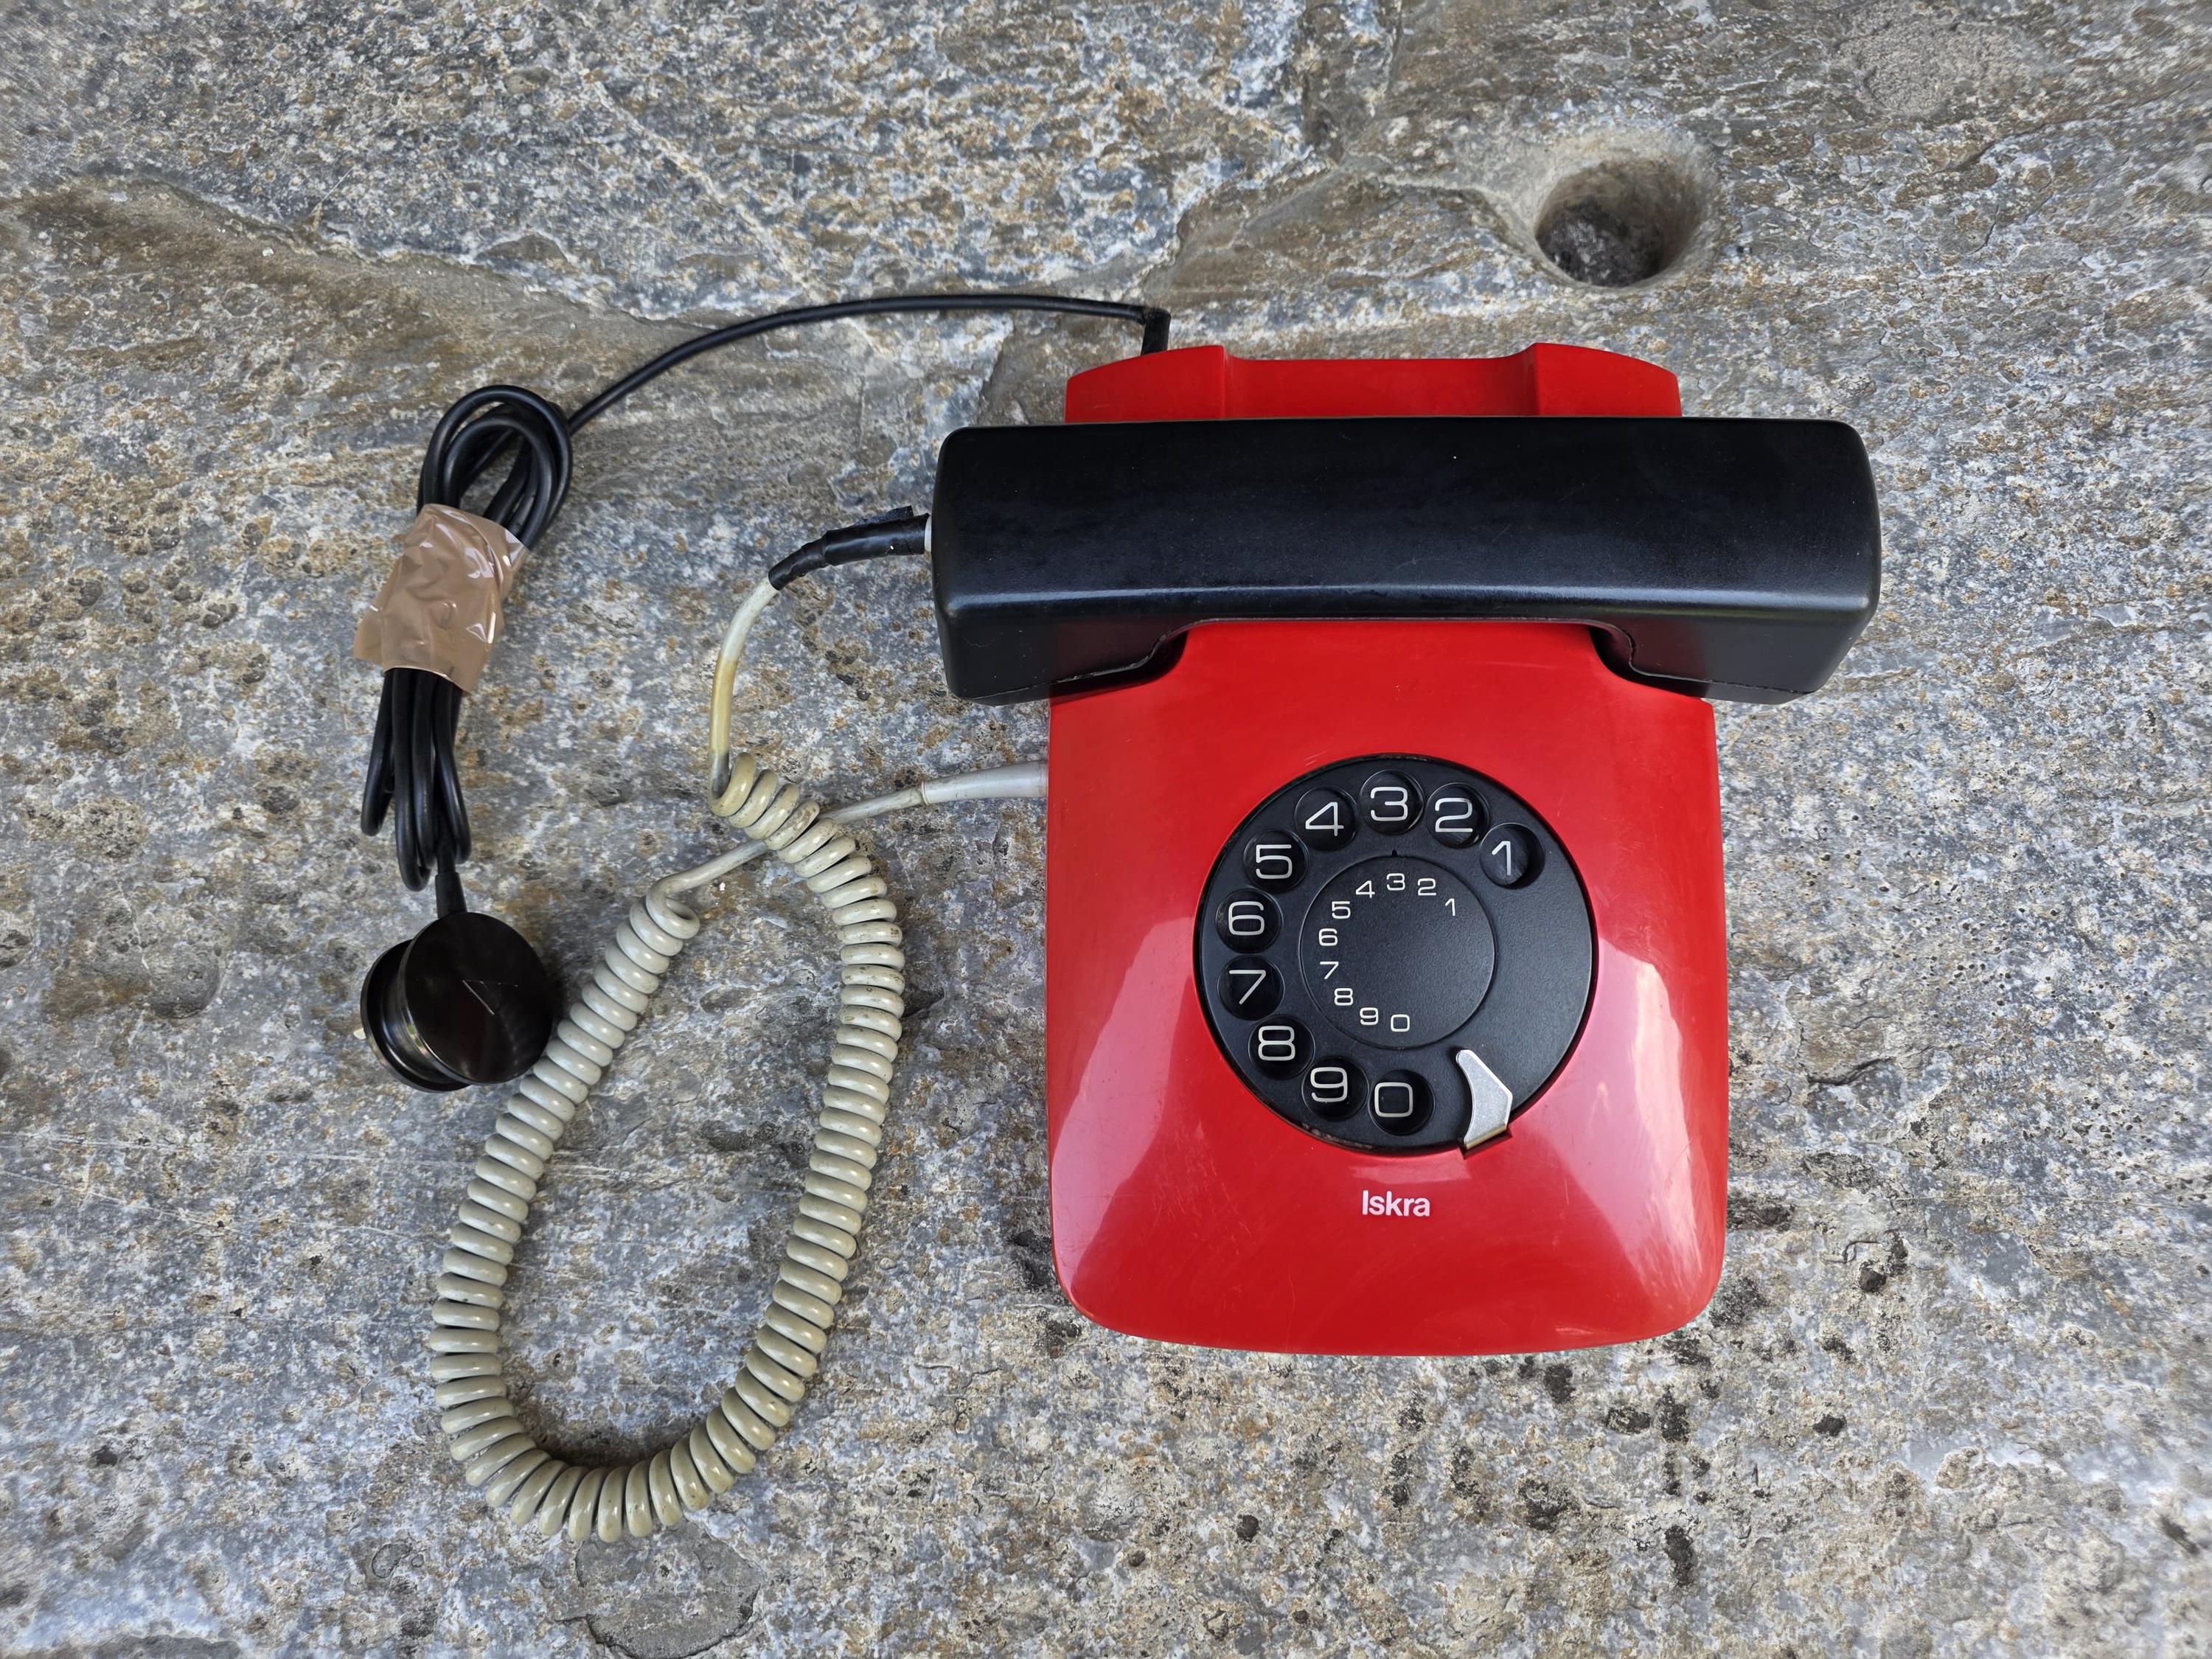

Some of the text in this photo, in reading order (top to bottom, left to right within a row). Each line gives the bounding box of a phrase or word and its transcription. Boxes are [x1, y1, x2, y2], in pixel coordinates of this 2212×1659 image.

[1370, 786, 1408, 821] 3
[1434, 797, 1473, 832] 2
[1305, 801, 1344, 836] 4
[1256, 844, 1293, 879] 5
[1491, 841, 1512, 876] 1
[1355, 880, 1376, 899] 4
[1386, 872, 1406, 891] 3
[1417, 877, 1437, 896] 2
[1228, 901, 1265, 936] 6
[1331, 900, 1351, 919] 5
[1444, 897, 1456, 917] 1
[1318, 928, 1338, 947] 6
[1319, 961, 1339, 980] 7
[1228, 970, 1266, 1005] 7
[1334, 987, 1354, 1006] 8
[1359, 1006, 1379, 1026] 9
[1390, 1014, 1411, 1032] 0
[1258, 1025, 1295, 1061] 8
[1310, 1066, 1348, 1103] 9
[1374, 1082, 1413, 1118] 0
[1362, 1190, 1430, 1217] Iskra
